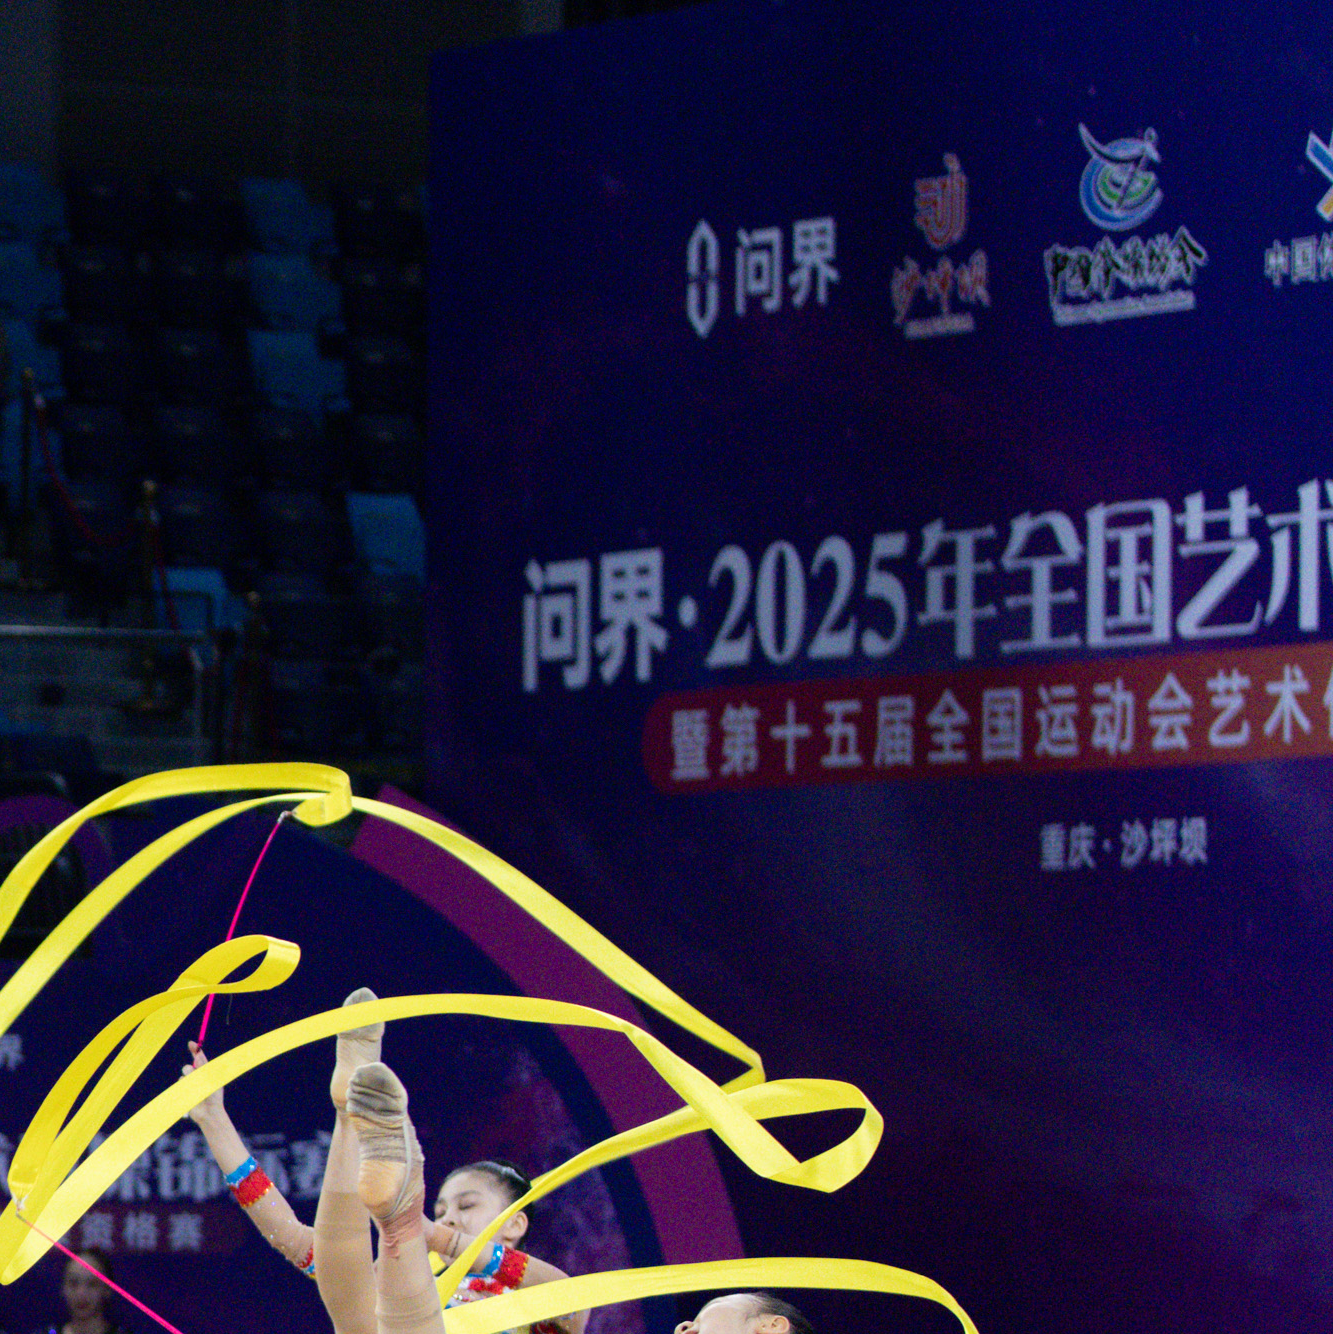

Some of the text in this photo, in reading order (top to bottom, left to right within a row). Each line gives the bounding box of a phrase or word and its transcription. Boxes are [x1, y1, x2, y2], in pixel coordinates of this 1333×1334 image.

[733, 217, 839, 317] 问界
[521, 477, 1333, 692] 问界·2025年全国艺术
[669, 664, 1333, 781] 暨第十五届全国运动会艺术
